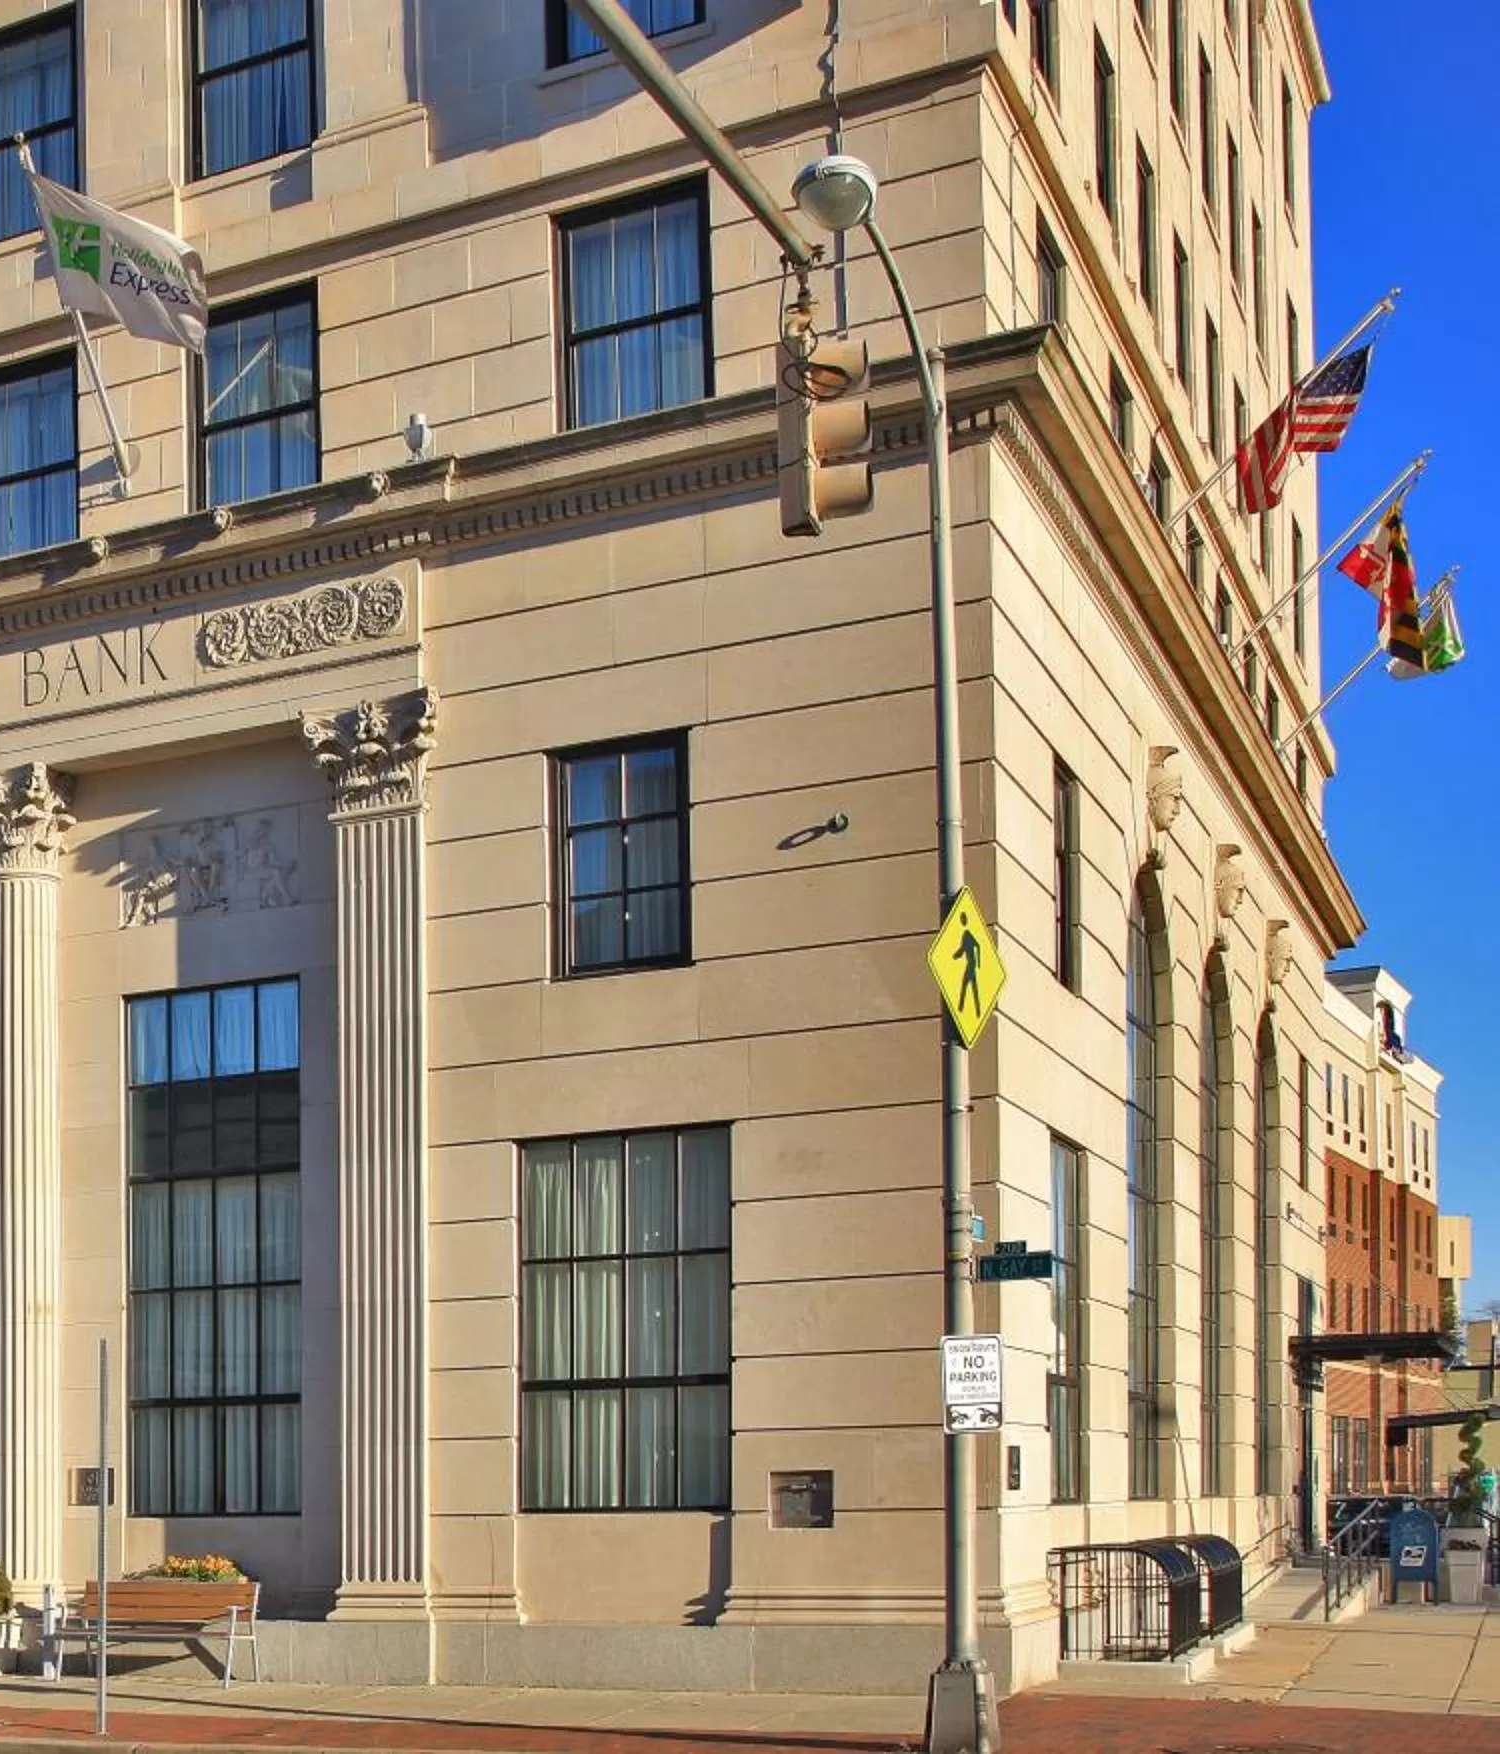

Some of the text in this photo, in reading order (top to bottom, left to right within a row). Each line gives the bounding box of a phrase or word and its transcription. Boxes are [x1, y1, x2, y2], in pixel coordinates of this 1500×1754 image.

[110, 261, 191, 304] Express
[21, 622, 168, 708] BANK
[1000, 1257, 1028, 1278] GAY
[963, 1355, 985, 1369] NO
[949, 1370, 997, 1383] PARKING
